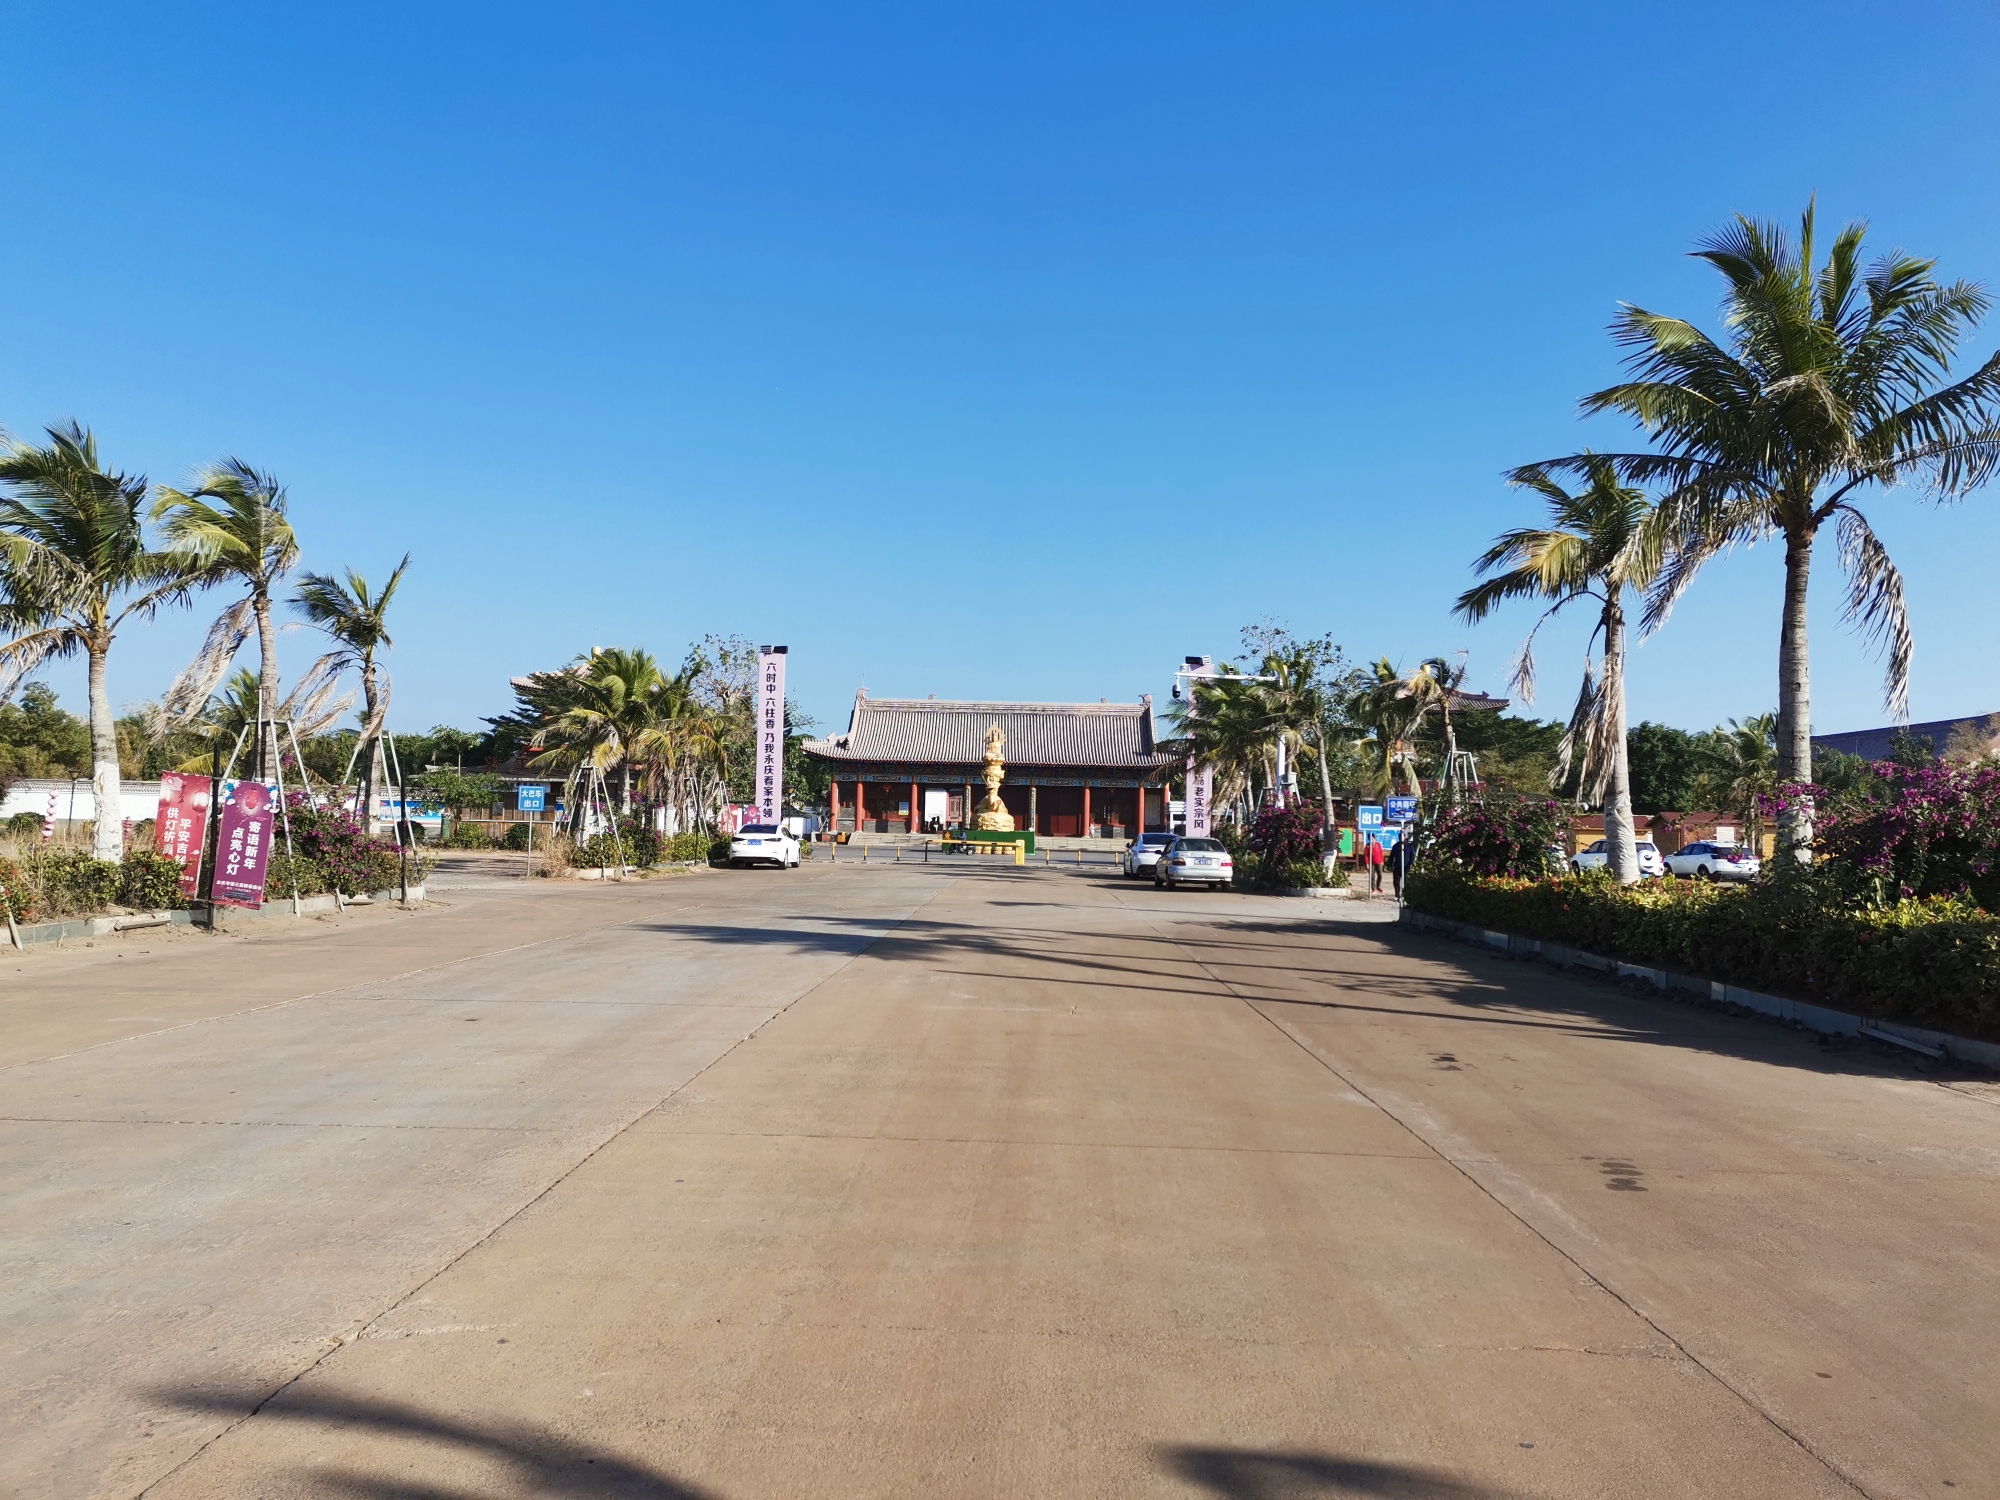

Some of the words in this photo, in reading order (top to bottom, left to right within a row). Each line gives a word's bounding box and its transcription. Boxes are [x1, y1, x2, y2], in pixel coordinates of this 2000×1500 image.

[765, 662, 777, 694] 六时中
[521, 789, 542, 798] 大巴车
[763, 732, 775, 819] 乃我永庆看家本领
[523, 799, 540, 808] 出口
[1361, 811, 1383, 825] 出口
[175, 818, 193, 866] 平安吉祥
[226, 827, 245, 876] 点亮心灯
[243, 821, 262, 870] 寄语新年
